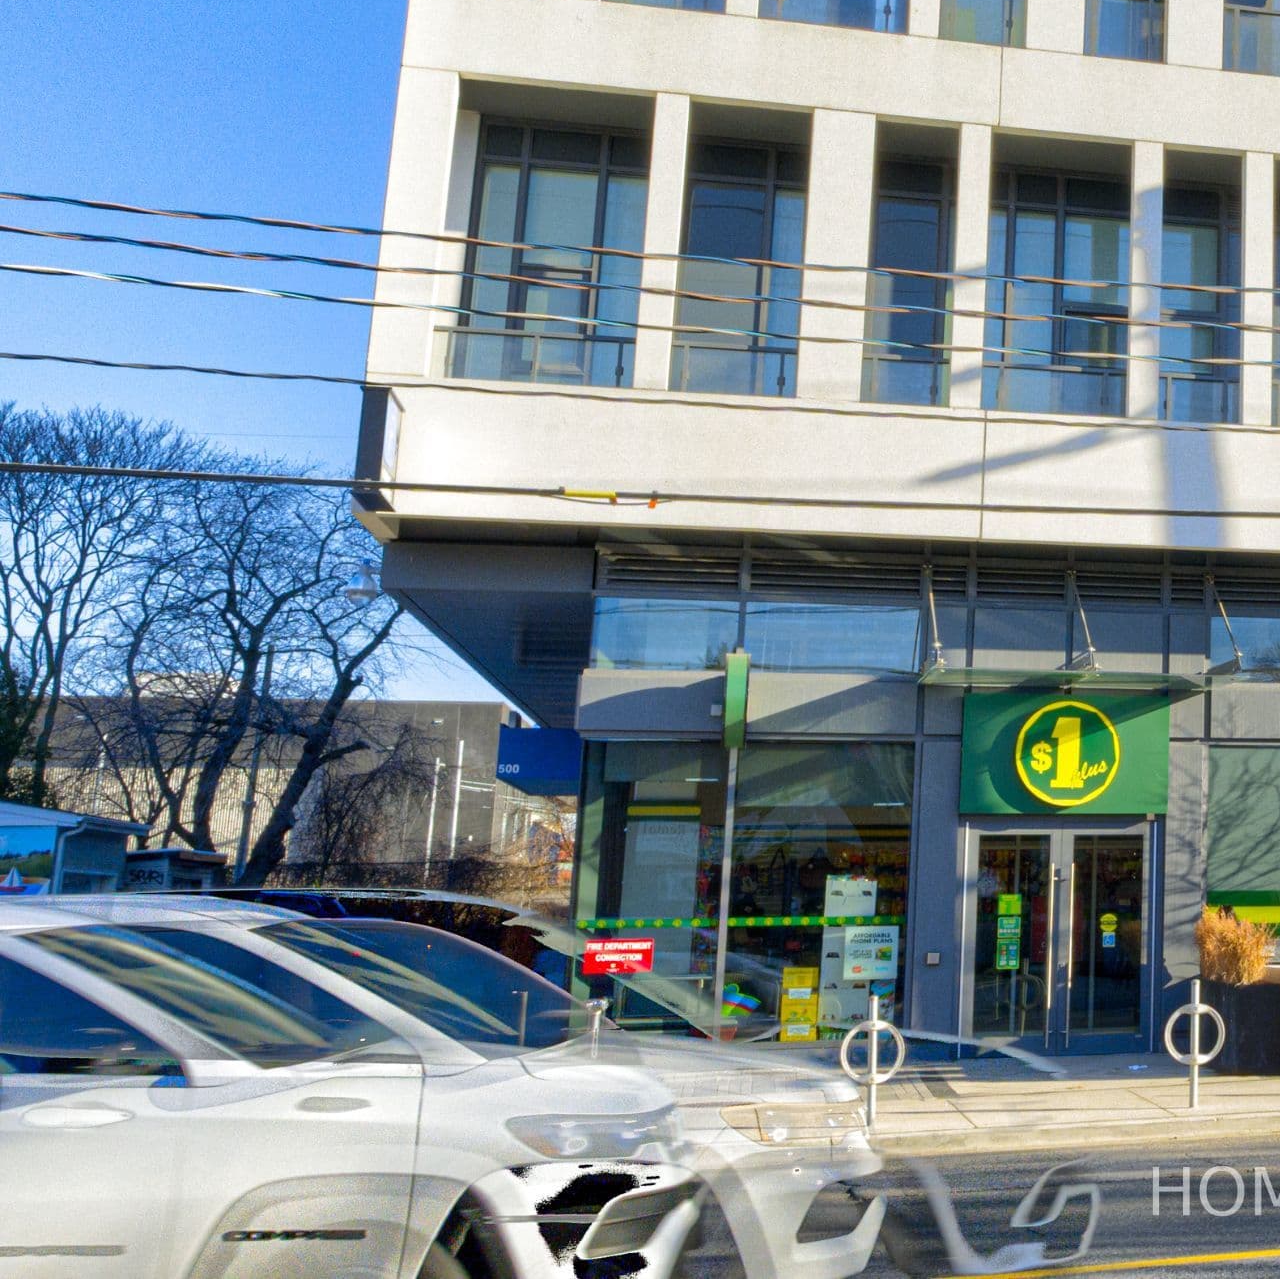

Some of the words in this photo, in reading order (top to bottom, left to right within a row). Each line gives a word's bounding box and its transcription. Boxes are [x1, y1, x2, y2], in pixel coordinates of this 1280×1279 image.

[498, 763, 520, 774] 500
[586, 942, 603, 950] FIRE
[604, 942, 652, 950] DEPARTMENT
[595, 953, 643, 962] CONNECTION
